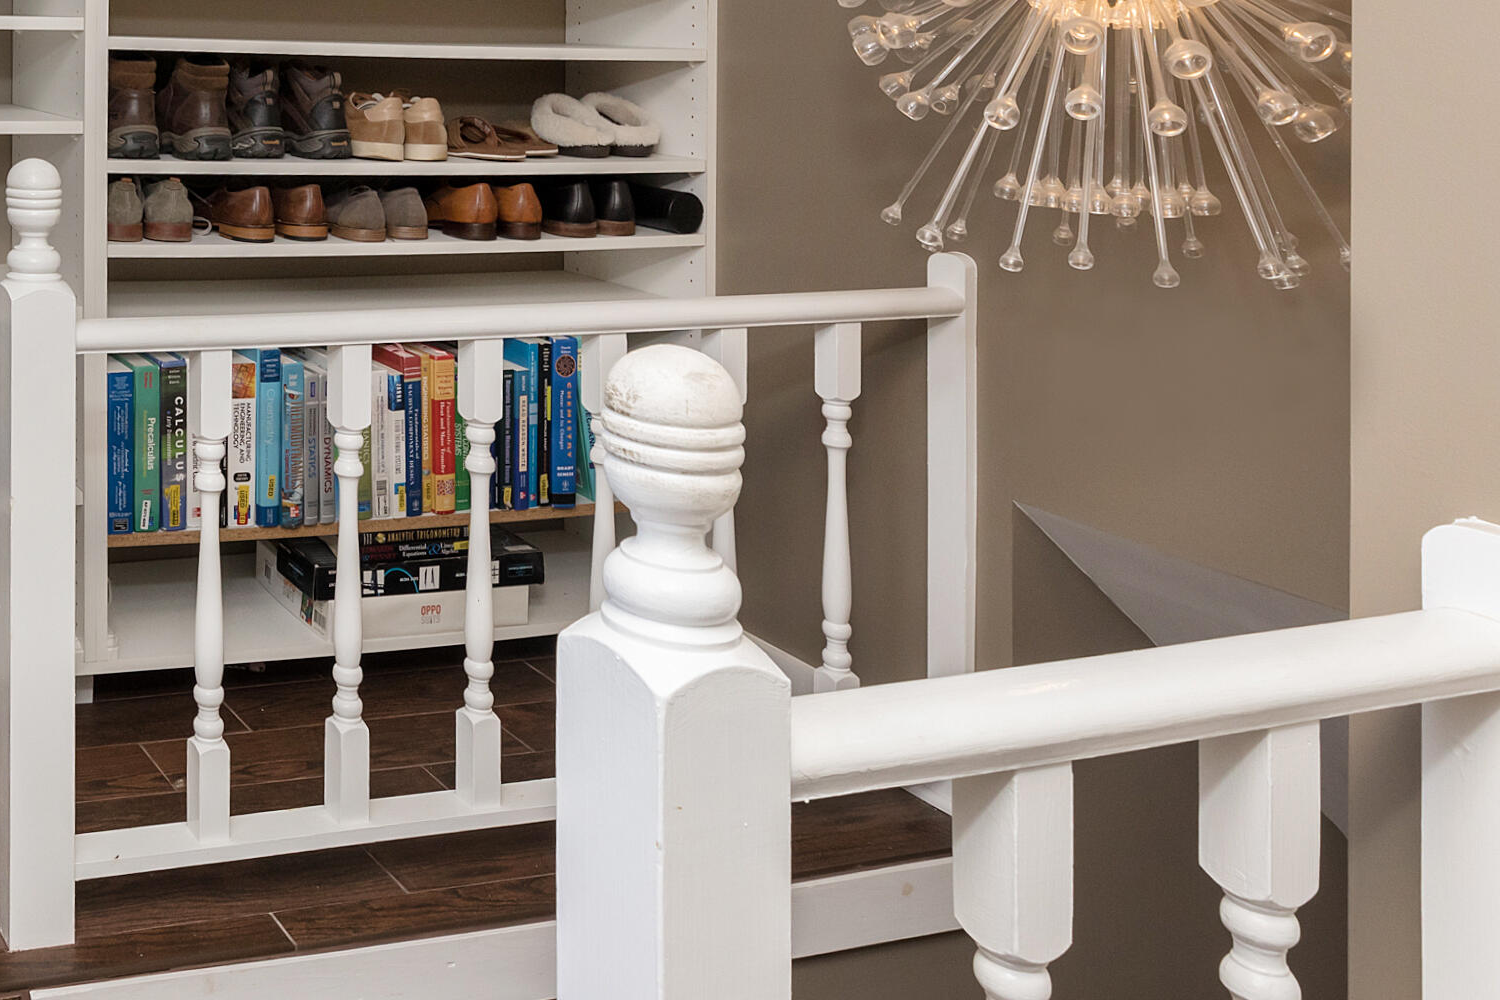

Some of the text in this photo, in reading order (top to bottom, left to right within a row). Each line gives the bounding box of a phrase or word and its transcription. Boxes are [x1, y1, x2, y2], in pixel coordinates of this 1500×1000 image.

[175, 396, 185, 482] CALCULUS
[265, 388, 277, 445] Chemistry
[147, 417, 156, 470] Precalculus
[290, 401, 304, 490] THERMODYNAMICS
[308, 437, 316, 478] STATICS
[324, 437, 332, 494] DYNAMICS
[387, 527, 461, 543] ANALYTIC TRIGONOMETRY
[399, 542, 427, 551] Differential
[402, 550, 427, 558] Equations
[421, 604, 442, 616] OPPO
